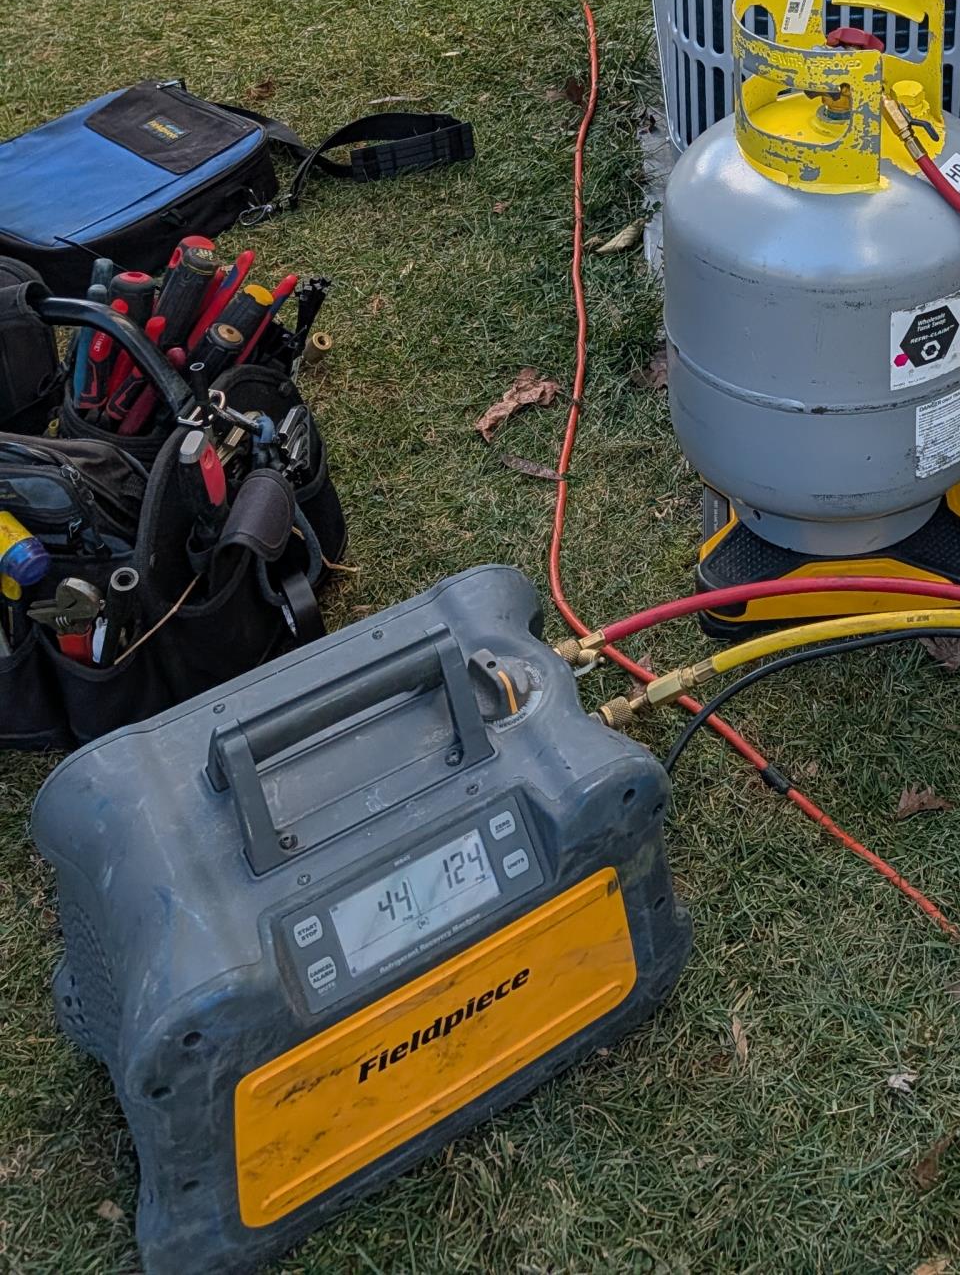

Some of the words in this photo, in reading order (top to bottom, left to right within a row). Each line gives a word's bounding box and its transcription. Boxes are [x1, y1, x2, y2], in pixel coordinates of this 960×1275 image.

[917, 312, 946, 326] Wholesale
[917, 322, 931, 333] Tank
[931, 318, 947, 329] Swap
[919, 399, 942, 412] DANGER
[378, 881, 412, 921] 44
[443, 842, 484, 889] 124
[297, 921, 317, 937] START
[301, 928, 318, 942] STOP
[379, 946, 420, 975] Refrigerant
[420, 929, 452, 953] Recovery
[452, 912, 481, 932] Machine
[310, 963, 332, 979] CANCEL
[312, 968, 335, 984] ALARM
[357, 967, 531, 1085] Fieldpiece
